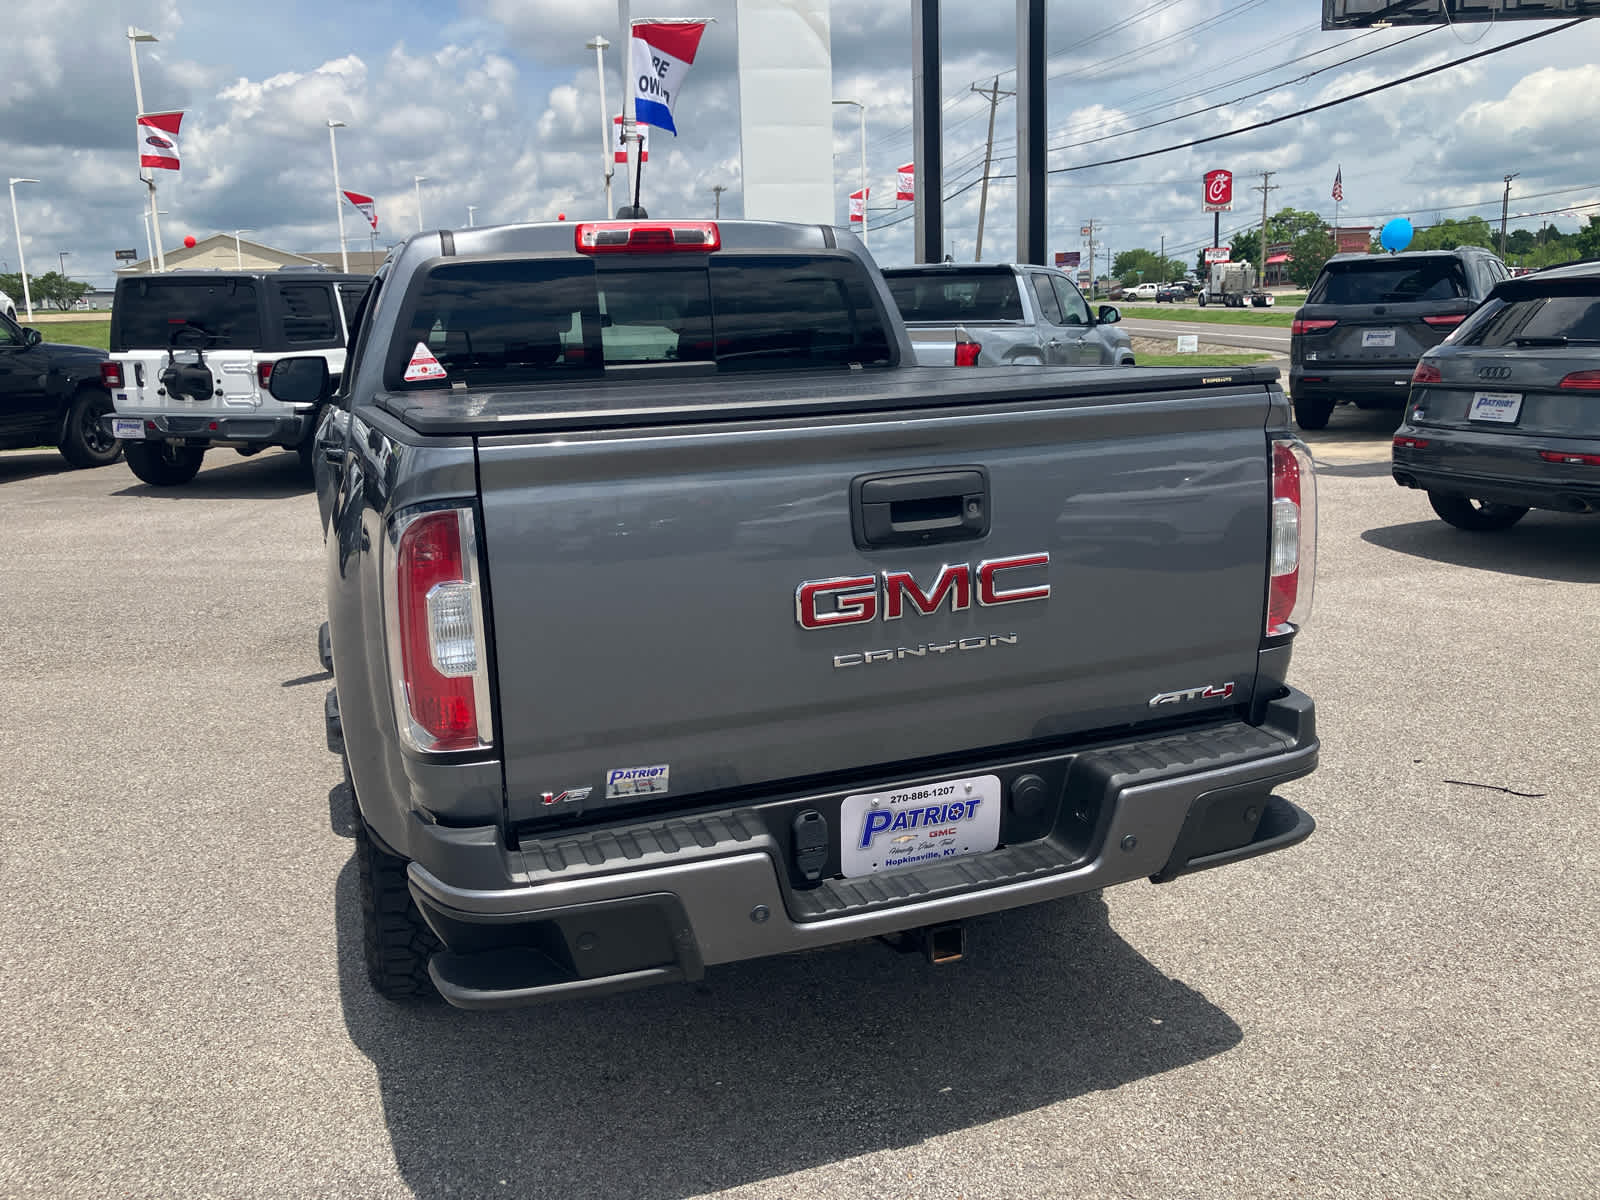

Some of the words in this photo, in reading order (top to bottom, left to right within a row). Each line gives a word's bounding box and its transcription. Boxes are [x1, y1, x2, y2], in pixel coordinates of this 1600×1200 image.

[796, 551, 1051, 630] GMC
[833, 632, 1018, 668] CANYON
[1148, 682, 1235, 705] AT4
[609, 767, 666, 785] PATRIOT
[541, 786, 593, 805] V6
[890, 786, 955, 804] 270-886-1207
[859, 799, 981, 849] PATRIOT
[928, 827, 958, 838] GMC
[885, 852, 942, 867] Hopkinsville,
[943, 847, 956, 857] KY
